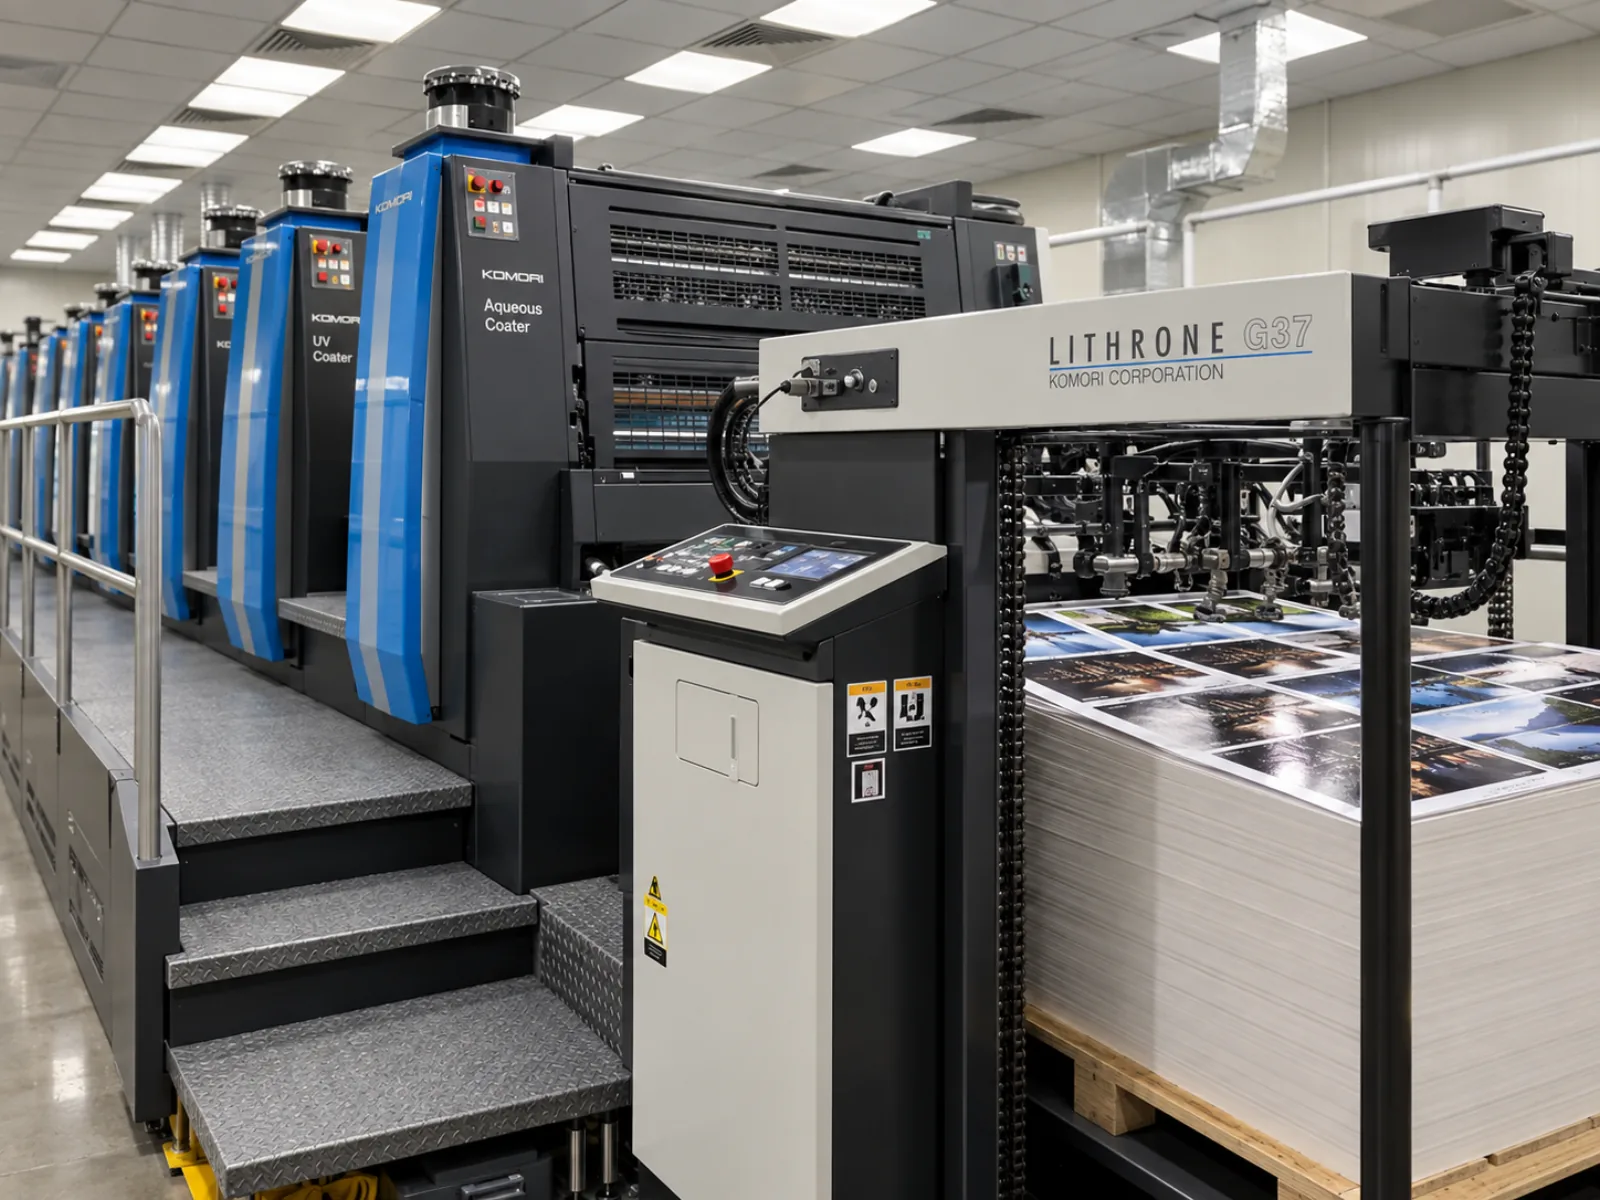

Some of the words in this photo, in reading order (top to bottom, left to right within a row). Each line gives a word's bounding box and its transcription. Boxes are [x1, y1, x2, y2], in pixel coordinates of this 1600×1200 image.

[375, 190, 413, 215] KOMORI
[482, 269, 544, 284] KOMORI
[484, 298, 543, 316] Aqueous
[311, 313, 360, 325] KOMOR
[485, 317, 530, 334] Coater
[312, 335, 331, 347] UV
[1050, 321, 1224, 366] LITHRONE
[1243, 314, 1313, 351] G37
[312, 350, 353, 363] Coater
[1050, 368, 1104, 390] KOMORI
[1109, 363, 1224, 387] CORPORATION
